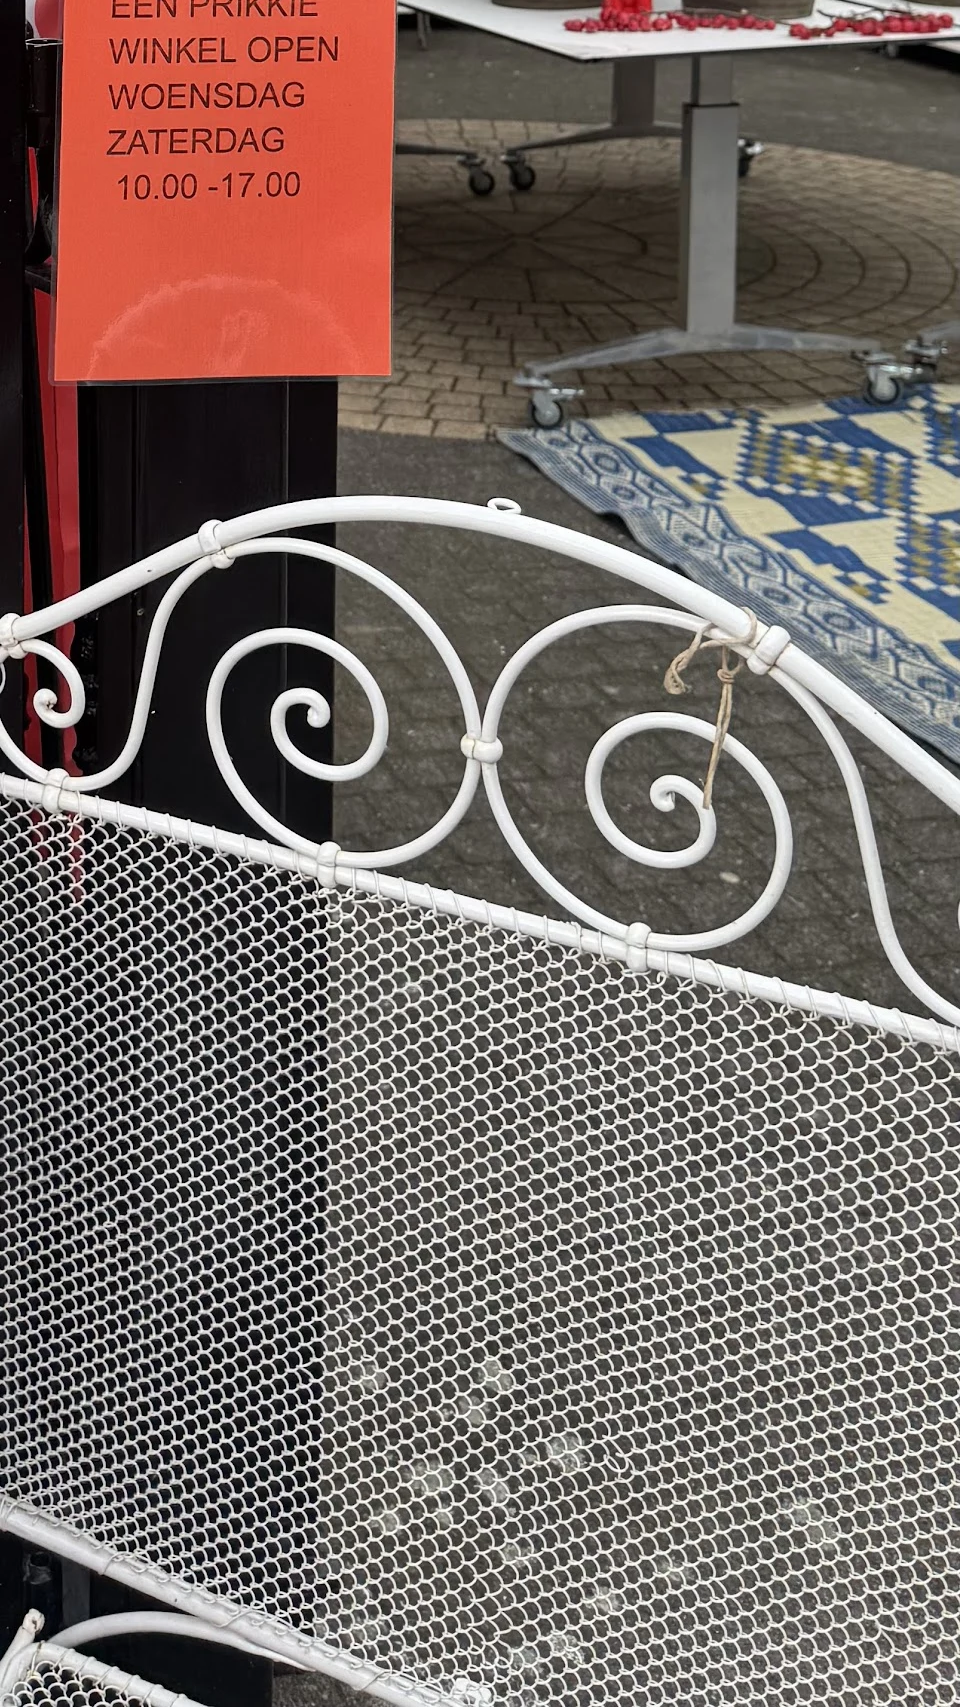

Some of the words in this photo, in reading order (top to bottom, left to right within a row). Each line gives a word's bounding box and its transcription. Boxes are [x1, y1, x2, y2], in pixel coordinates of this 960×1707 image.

[109, 37, 237, 65] WINKEL
[247, 36, 339, 63] OPEN
[108, 81, 306, 110] WOENSDAG
[106, 126, 285, 156] ZATERDAG
[117, 173, 198, 200] 10.00
[208, 171, 301, 198] -17.00
